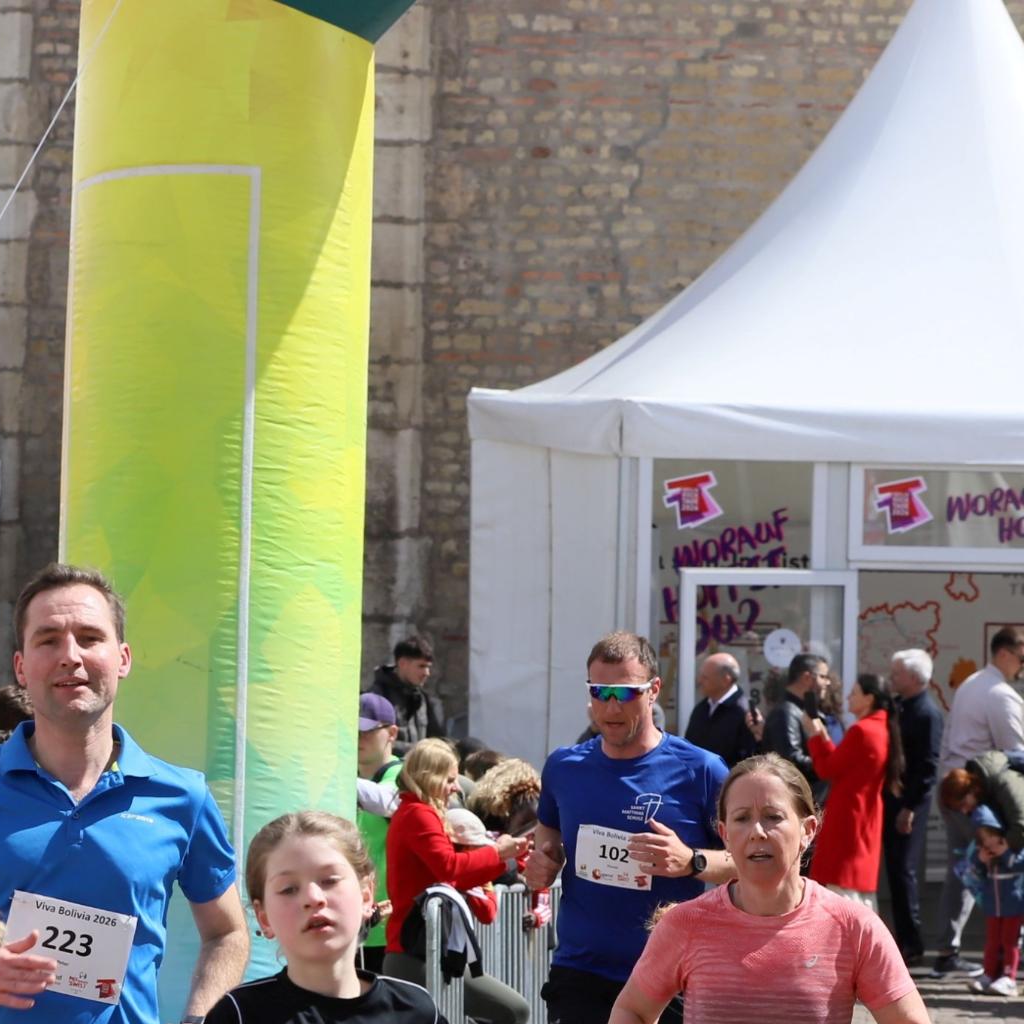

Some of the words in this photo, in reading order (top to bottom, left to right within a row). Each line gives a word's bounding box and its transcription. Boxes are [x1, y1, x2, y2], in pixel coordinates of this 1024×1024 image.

[946, 487, 1024, 523] WORA
[673, 508, 789, 573] WORAUF
[592, 828, 605, 838] Viva
[606, 830, 627, 841] Bolivia
[598, 844, 630, 864] 102
[35, 900, 56, 913] Viva
[58, 906, 92, 922] Bolivia
[93, 913, 118, 928] 2026
[41, 925, 95, 957] 223
